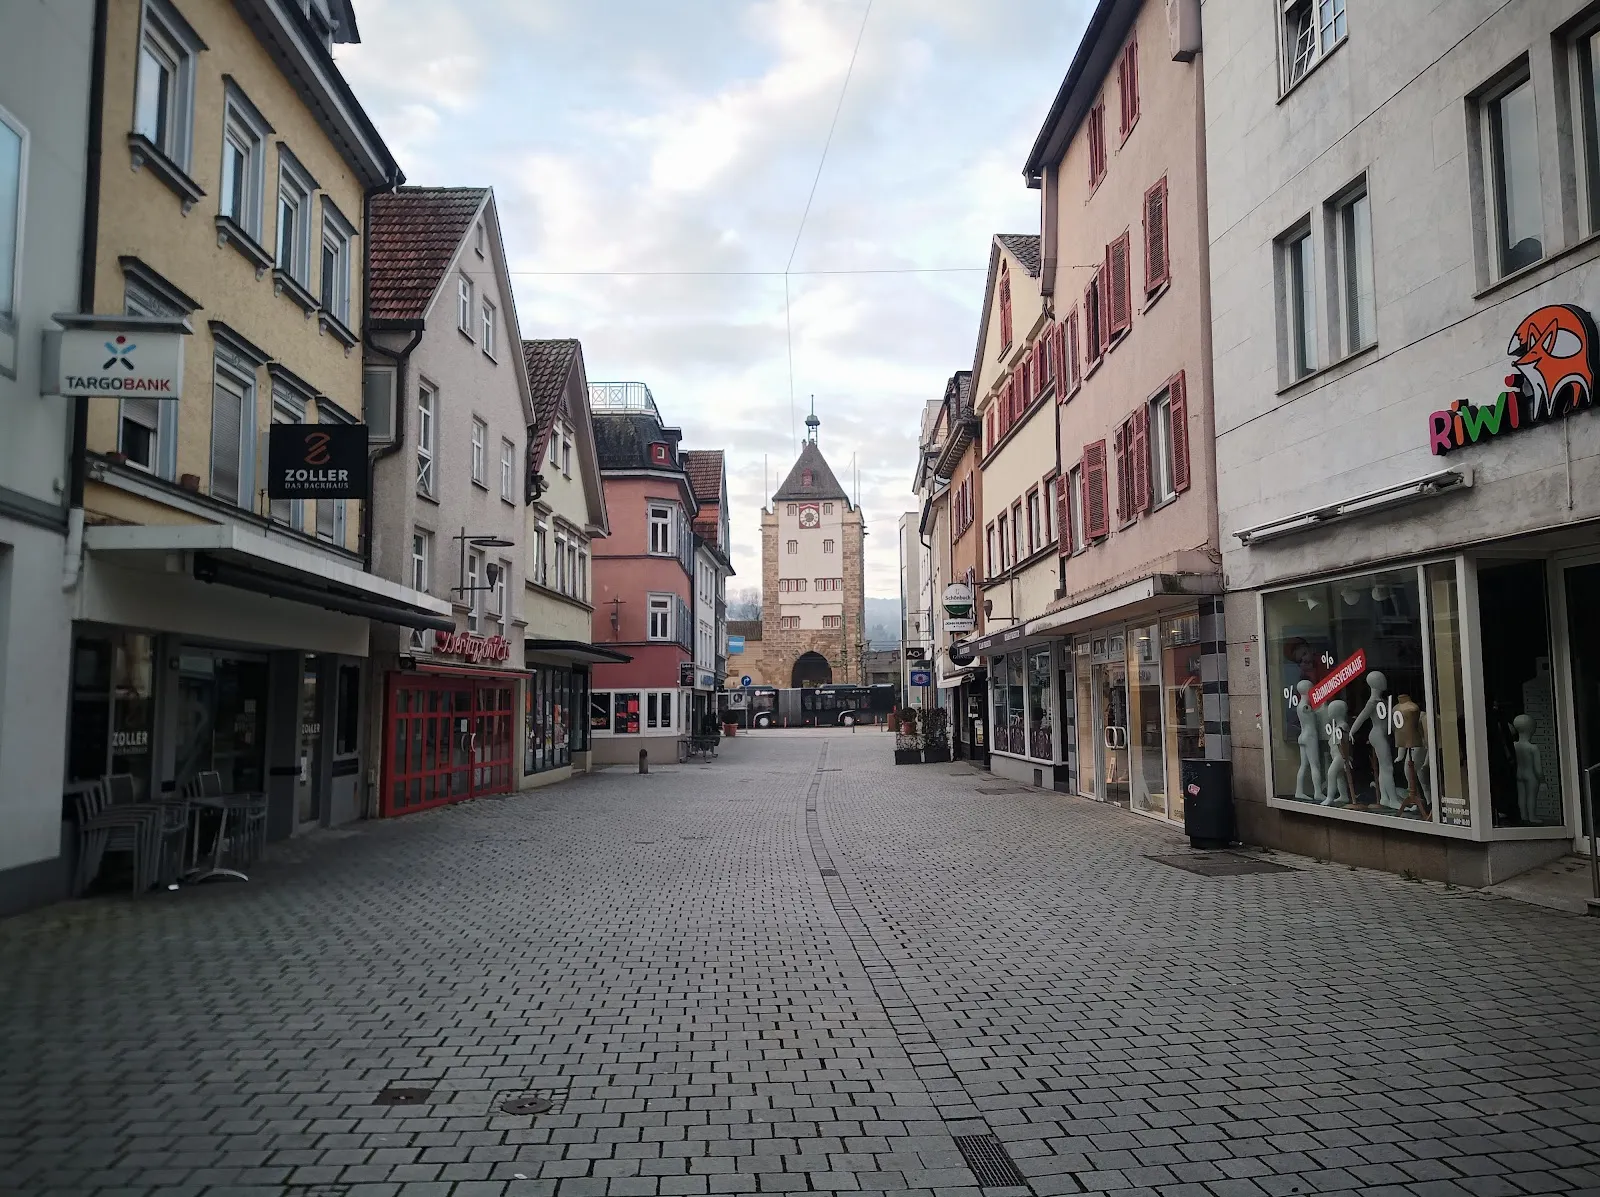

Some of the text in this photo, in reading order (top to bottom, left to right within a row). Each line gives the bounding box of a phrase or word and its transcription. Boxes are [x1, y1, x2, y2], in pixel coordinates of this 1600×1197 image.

[65, 375, 171, 392] TARGOBANK
[284, 469, 349, 482] ZOLLER
[1311, 655, 1363, 704] RÄUMUNGSVERKAUF
[1283, 685, 1299, 709] %
[1376, 694, 1404, 735] %
[112, 731, 148, 746] ZOLLER
[1325, 718, 1343, 744] %
